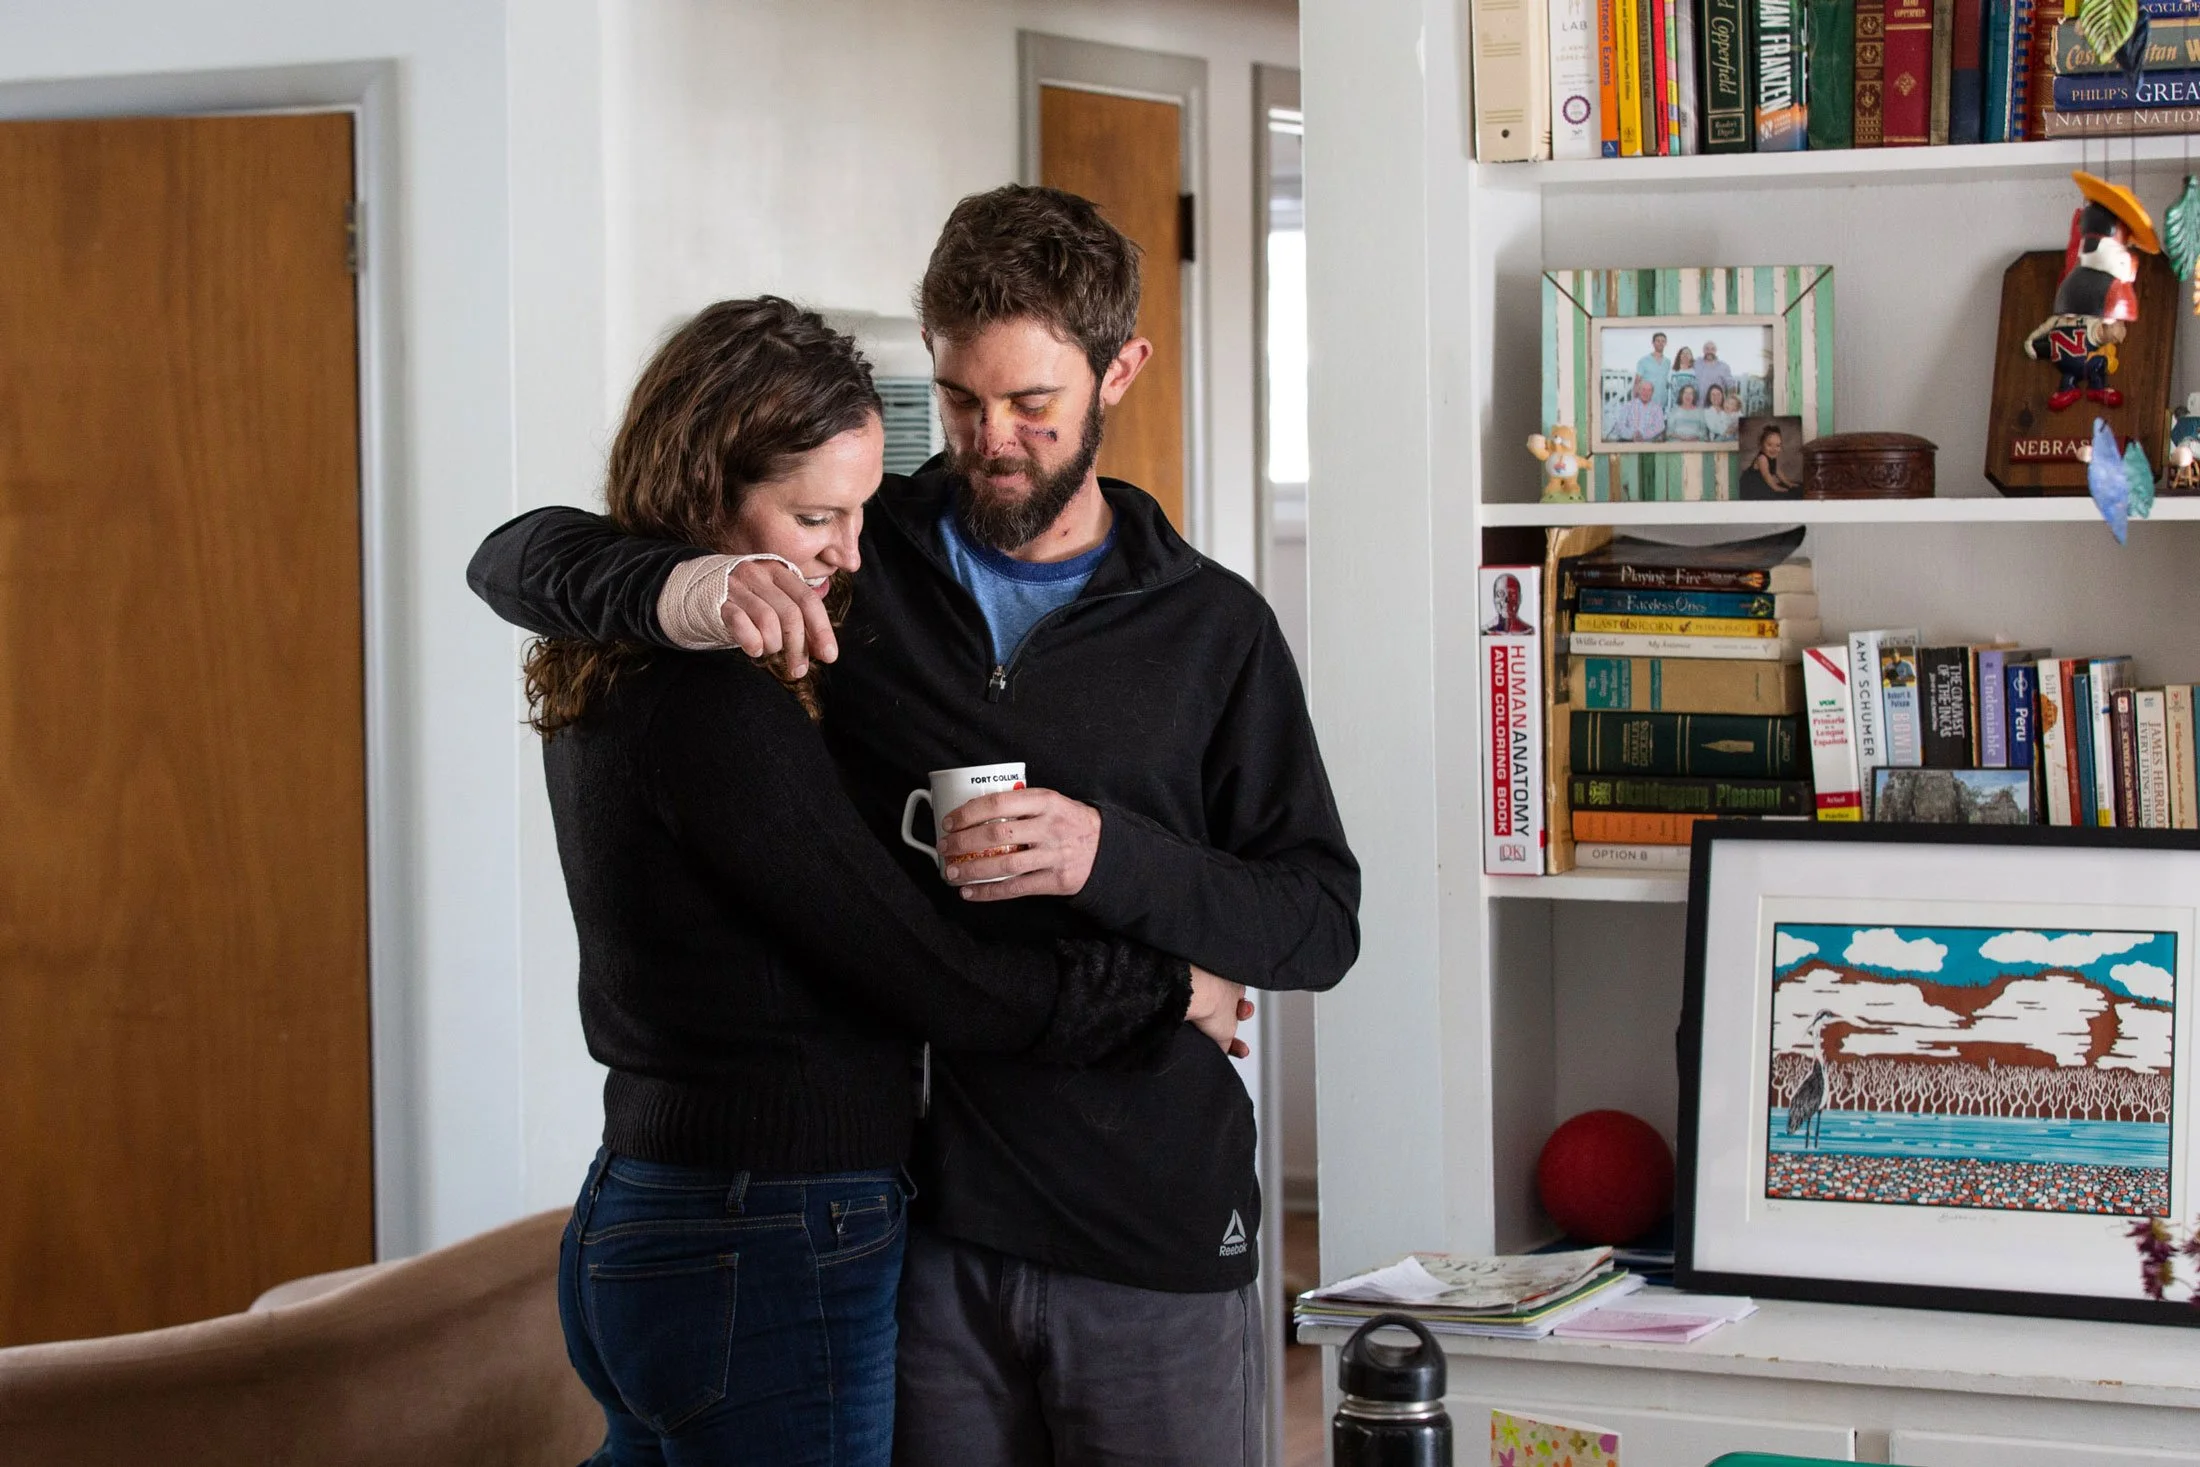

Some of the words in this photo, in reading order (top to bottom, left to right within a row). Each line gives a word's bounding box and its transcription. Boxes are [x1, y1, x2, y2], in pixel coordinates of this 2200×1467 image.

[1562, 20, 1588, 32] LAB
[1602, 0, 1610, 41] trance
[1602, 46, 1611, 86] Exams
[1711, 16, 1737, 94] Copperfield
[1760, 34, 1792, 116] FRANZEN
[2071, 87, 2128, 101] PHILIP'S
[2136, 81, 2200, 102] GREA
[2056, 111, 2124, 126] NATIVE
[2050, 329, 2087, 362] N
[1621, 564, 1666, 585] Playing
[1675, 567, 1701, 585] Fire
[1675, 595, 1708, 612] Ones
[1592, 617, 1619, 630] LAST
[1494, 649, 1505, 687] AND
[1856, 640, 1868, 673] AMY
[1950, 662, 1963, 687] THE
[1938, 681, 1951, 703] THE
[1813, 716, 1846, 726] Primaria
[1859, 680, 1875, 757] SCHUMER
[1938, 706, 1952, 738] INCAS
[1951, 686, 1966, 739] CONQUEST
[1984, 674, 2000, 756] Undeniable
[2015, 707, 2029, 742] Peru
[1495, 693, 1507, 780] COLORING
[1816, 728, 1844, 738] Lengua
[2140, 722, 2150, 753] EVERY
[2148, 720, 2163, 766] JAMES
[970, 776, 992, 785] FORT
[992, 773, 1019, 782] COLLINS
[2141, 758, 2151, 795] LIVING
[1497, 786, 1508, 834] BOOK
[1716, 783, 1782, 810] Pleasant
[2153, 770, 2166, 828] HERRIO
[2143, 798, 2152, 828] THIN
[1500, 844, 1526, 862] DK
[1592, 848, 1636, 861] OPTION
[1640, 850, 1648, 861] B
[1219, 1242, 1248, 1257] Reebok
